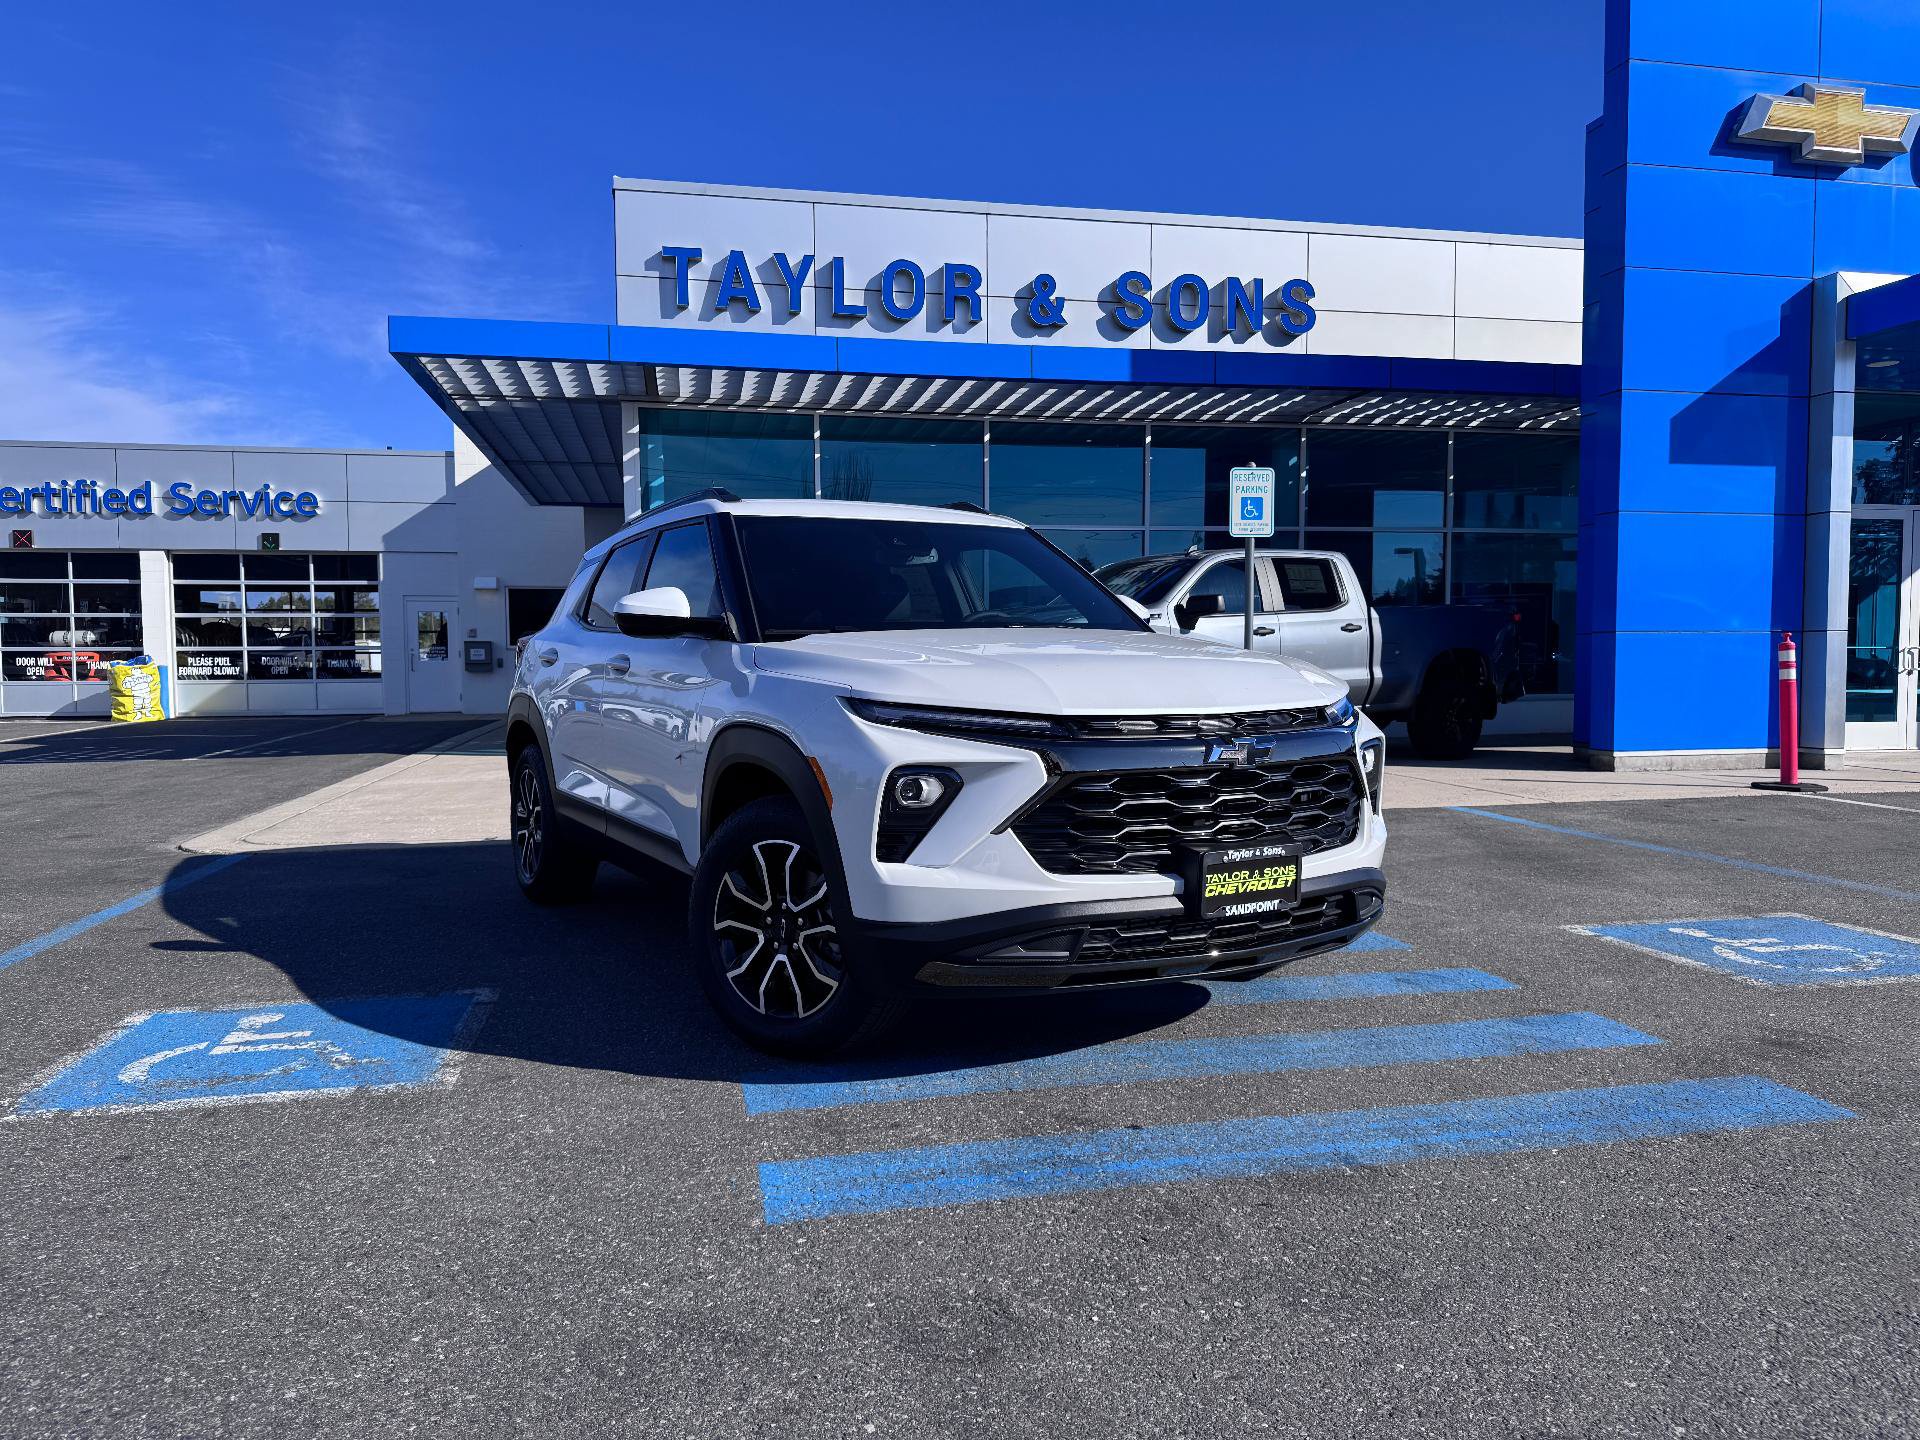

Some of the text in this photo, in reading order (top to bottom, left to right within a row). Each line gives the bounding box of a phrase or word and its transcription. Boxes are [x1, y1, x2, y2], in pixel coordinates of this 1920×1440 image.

[661, 245, 1317, 336] TAYLOR & SONS
[1233, 473, 1270, 482] RESERVED
[1235, 485, 1268, 494] PARKING
[169, 482, 319, 517] Service
[15, 657, 54, 667] DOOR WILL
[187, 656, 213, 666] PLEASE
[261, 656, 280, 666] DOOR
[26, 666, 45, 676] OPEN
[178, 666, 240, 676] FORWARD SLOWLY
[271, 667, 289, 675] OPEN
[1227, 846, 1282, 862] Taylor & Sons
[1205, 865, 1297, 884] TAYLOR & SONS
[1204, 876, 1297, 898] CHEVROLET
[1225, 899, 1280, 917] SANDPOINT
